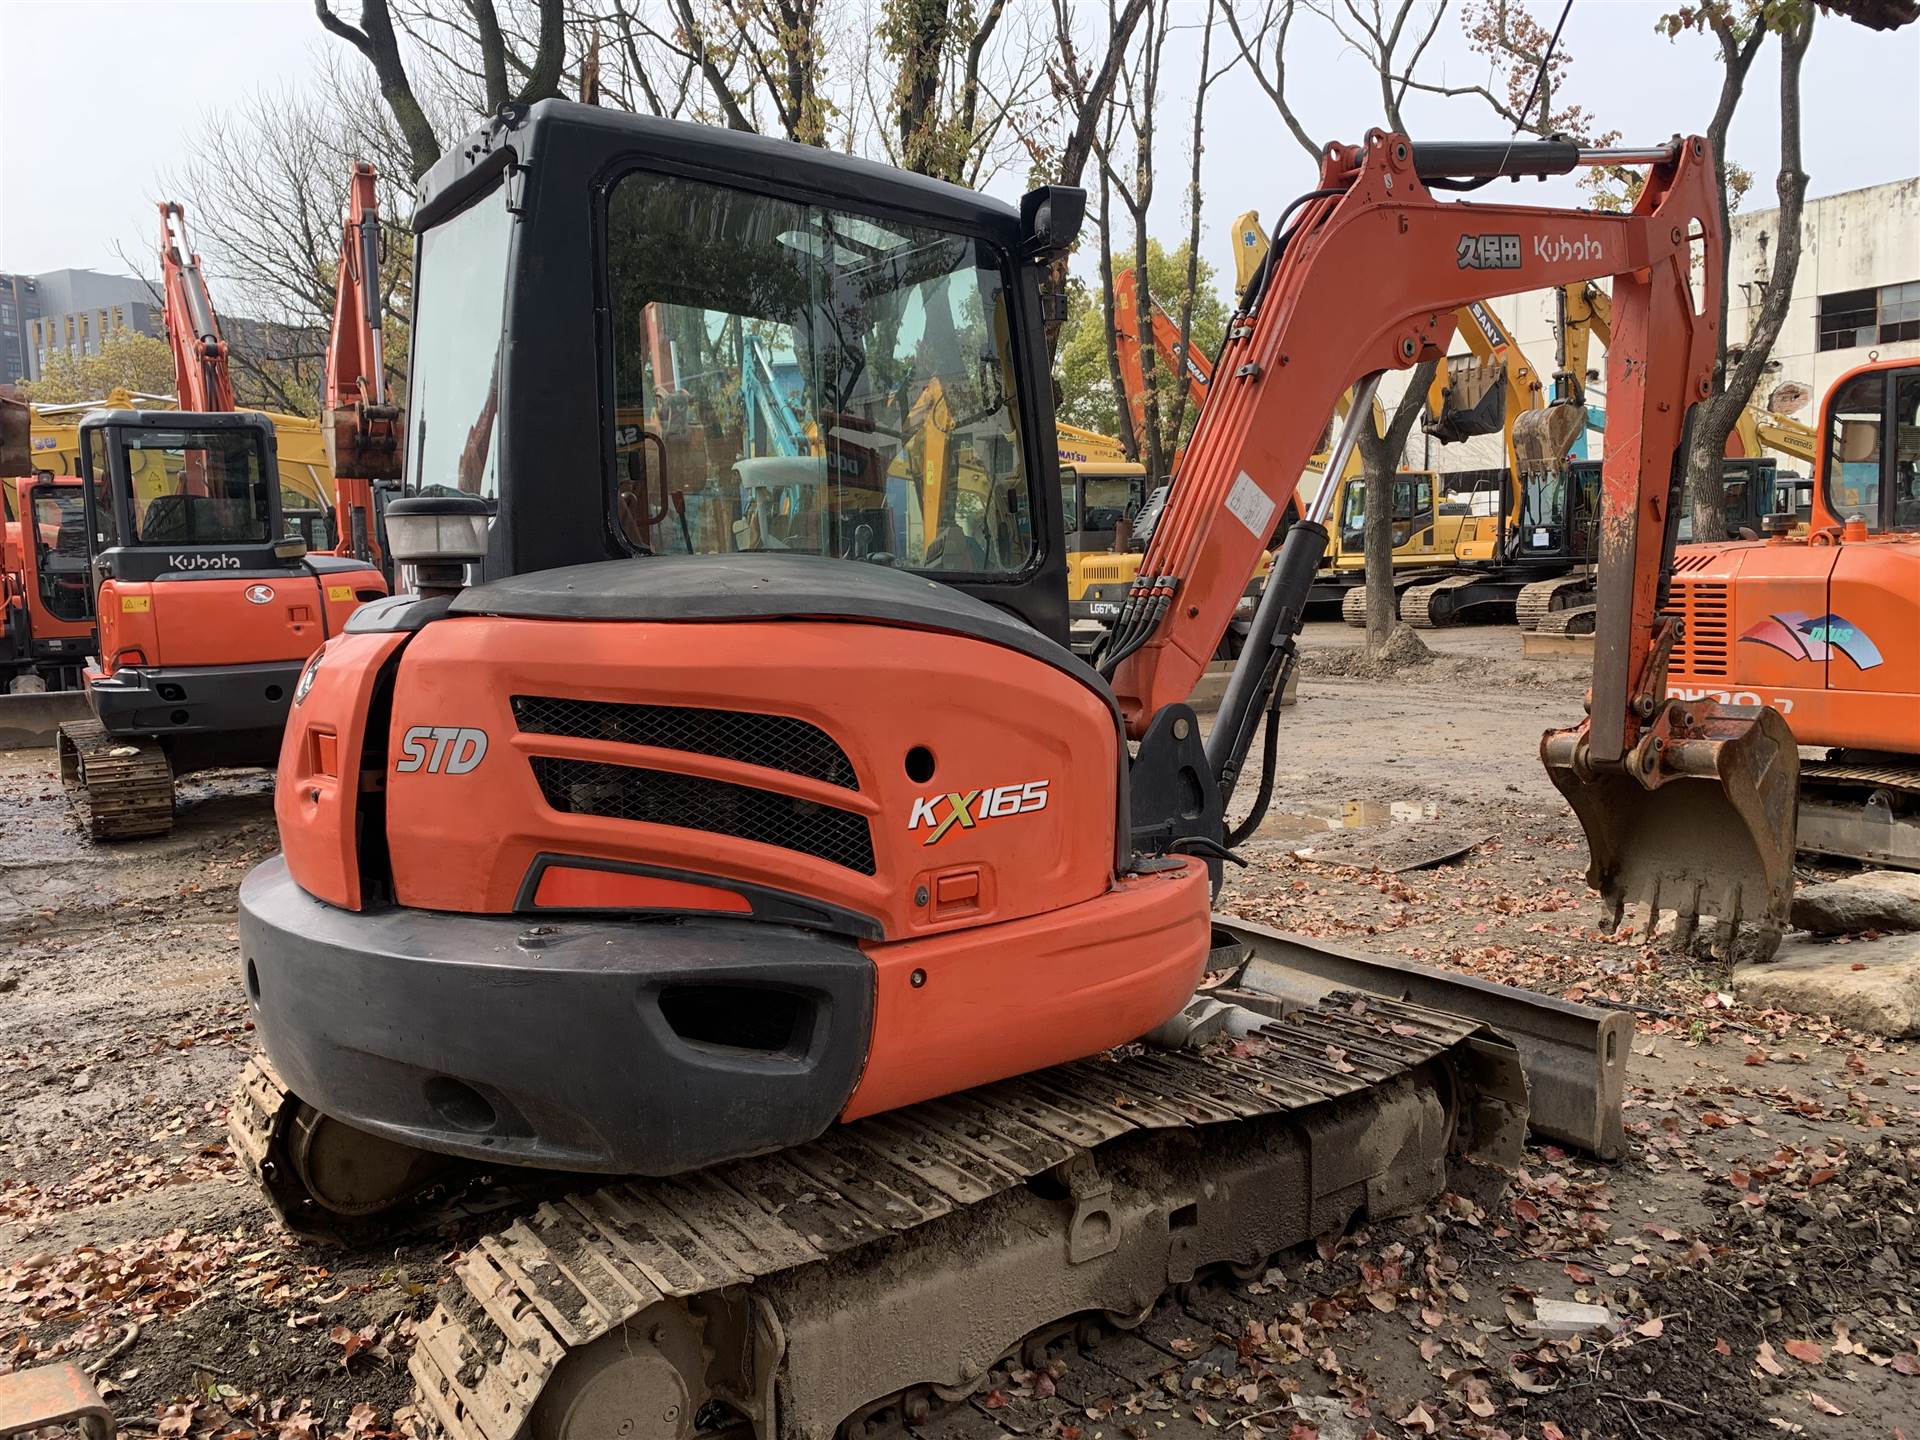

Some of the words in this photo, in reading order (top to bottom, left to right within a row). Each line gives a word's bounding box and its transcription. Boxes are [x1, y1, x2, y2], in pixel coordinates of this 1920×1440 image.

[1457, 234, 1521, 270] 久保田
[1533, 233, 1603, 263] Kubota
[1472, 303, 1500, 345] SANY
[169, 553, 240, 570] Kubota
[1808, 624, 1854, 644] plus
[396, 725, 490, 775] STD
[907, 778, 1051, 846] KX165
